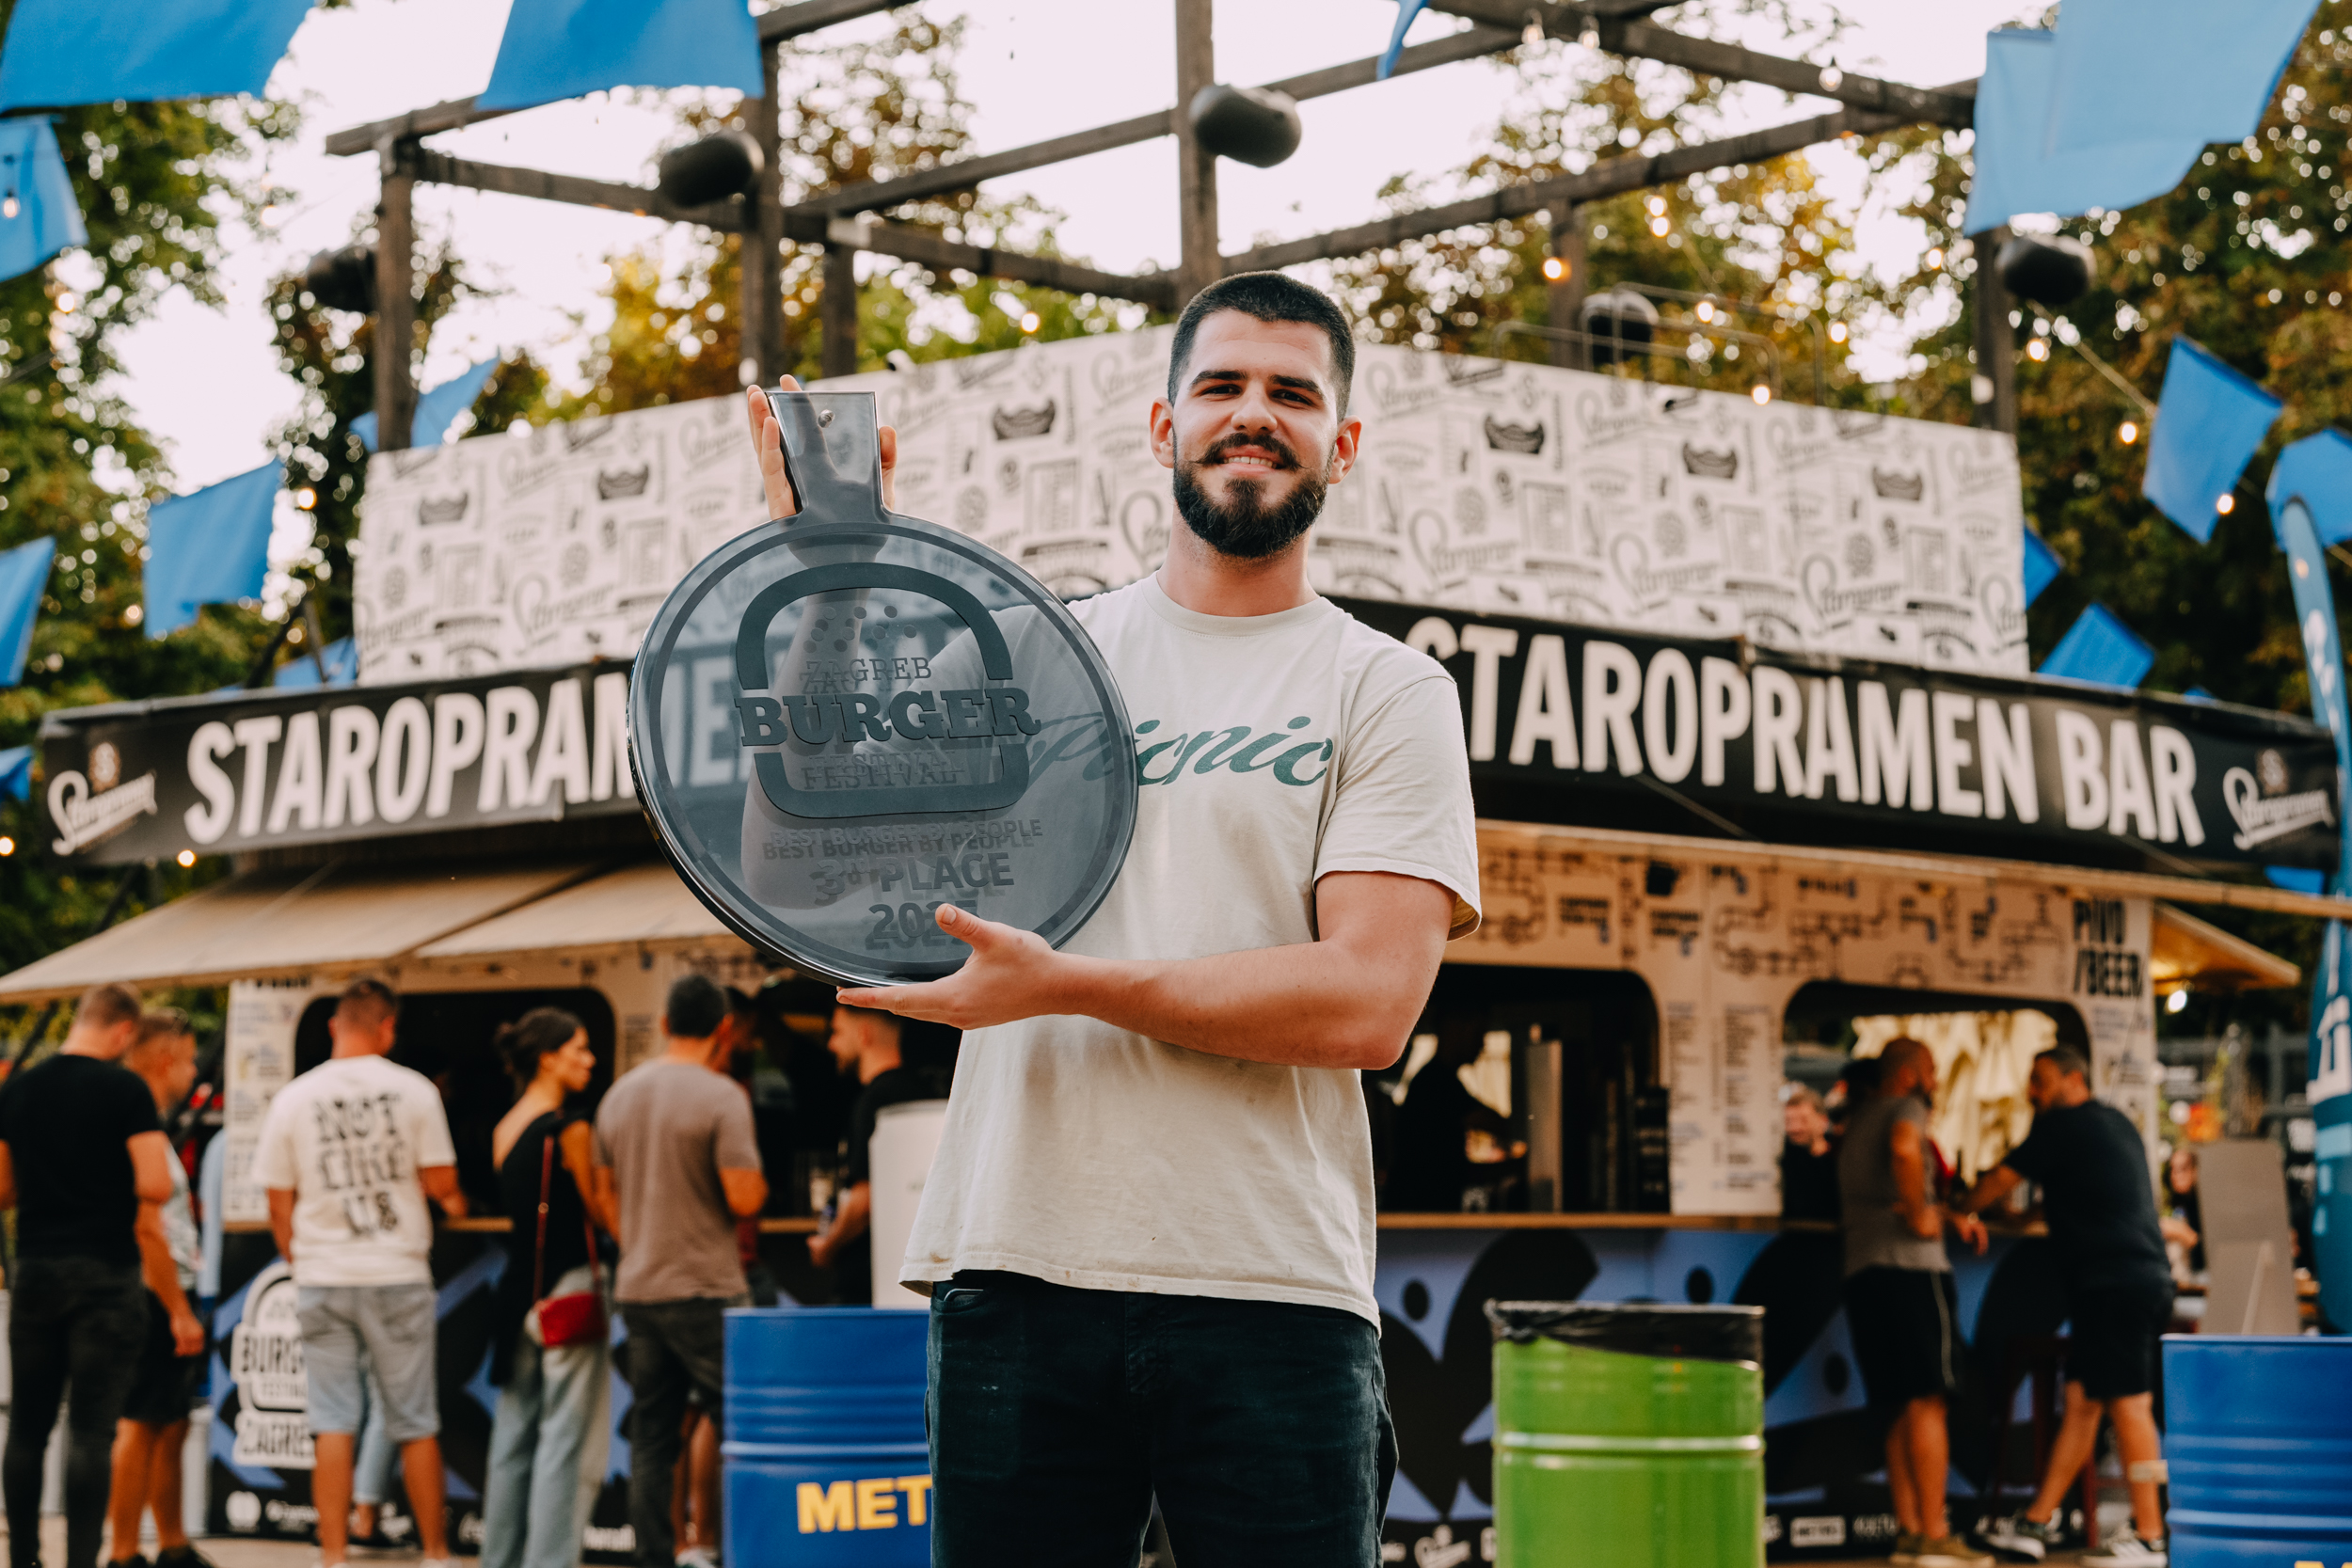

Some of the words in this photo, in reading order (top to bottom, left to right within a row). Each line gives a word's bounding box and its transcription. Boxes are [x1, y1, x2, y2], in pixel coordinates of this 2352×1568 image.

[805, 657, 932, 683] ZAGREB
[734, 687, 1041, 747] BURGER
[804, 751, 966, 784] FESTIVAL
[2055, 708, 2206, 847] BAR
[771, 828, 824, 847] BEST
[829, 823, 923, 846] BURGER
[961, 818, 1043, 840] PEOPLE
[876, 852, 1015, 892] PLACE
[796, 1474, 933, 1534] MET
